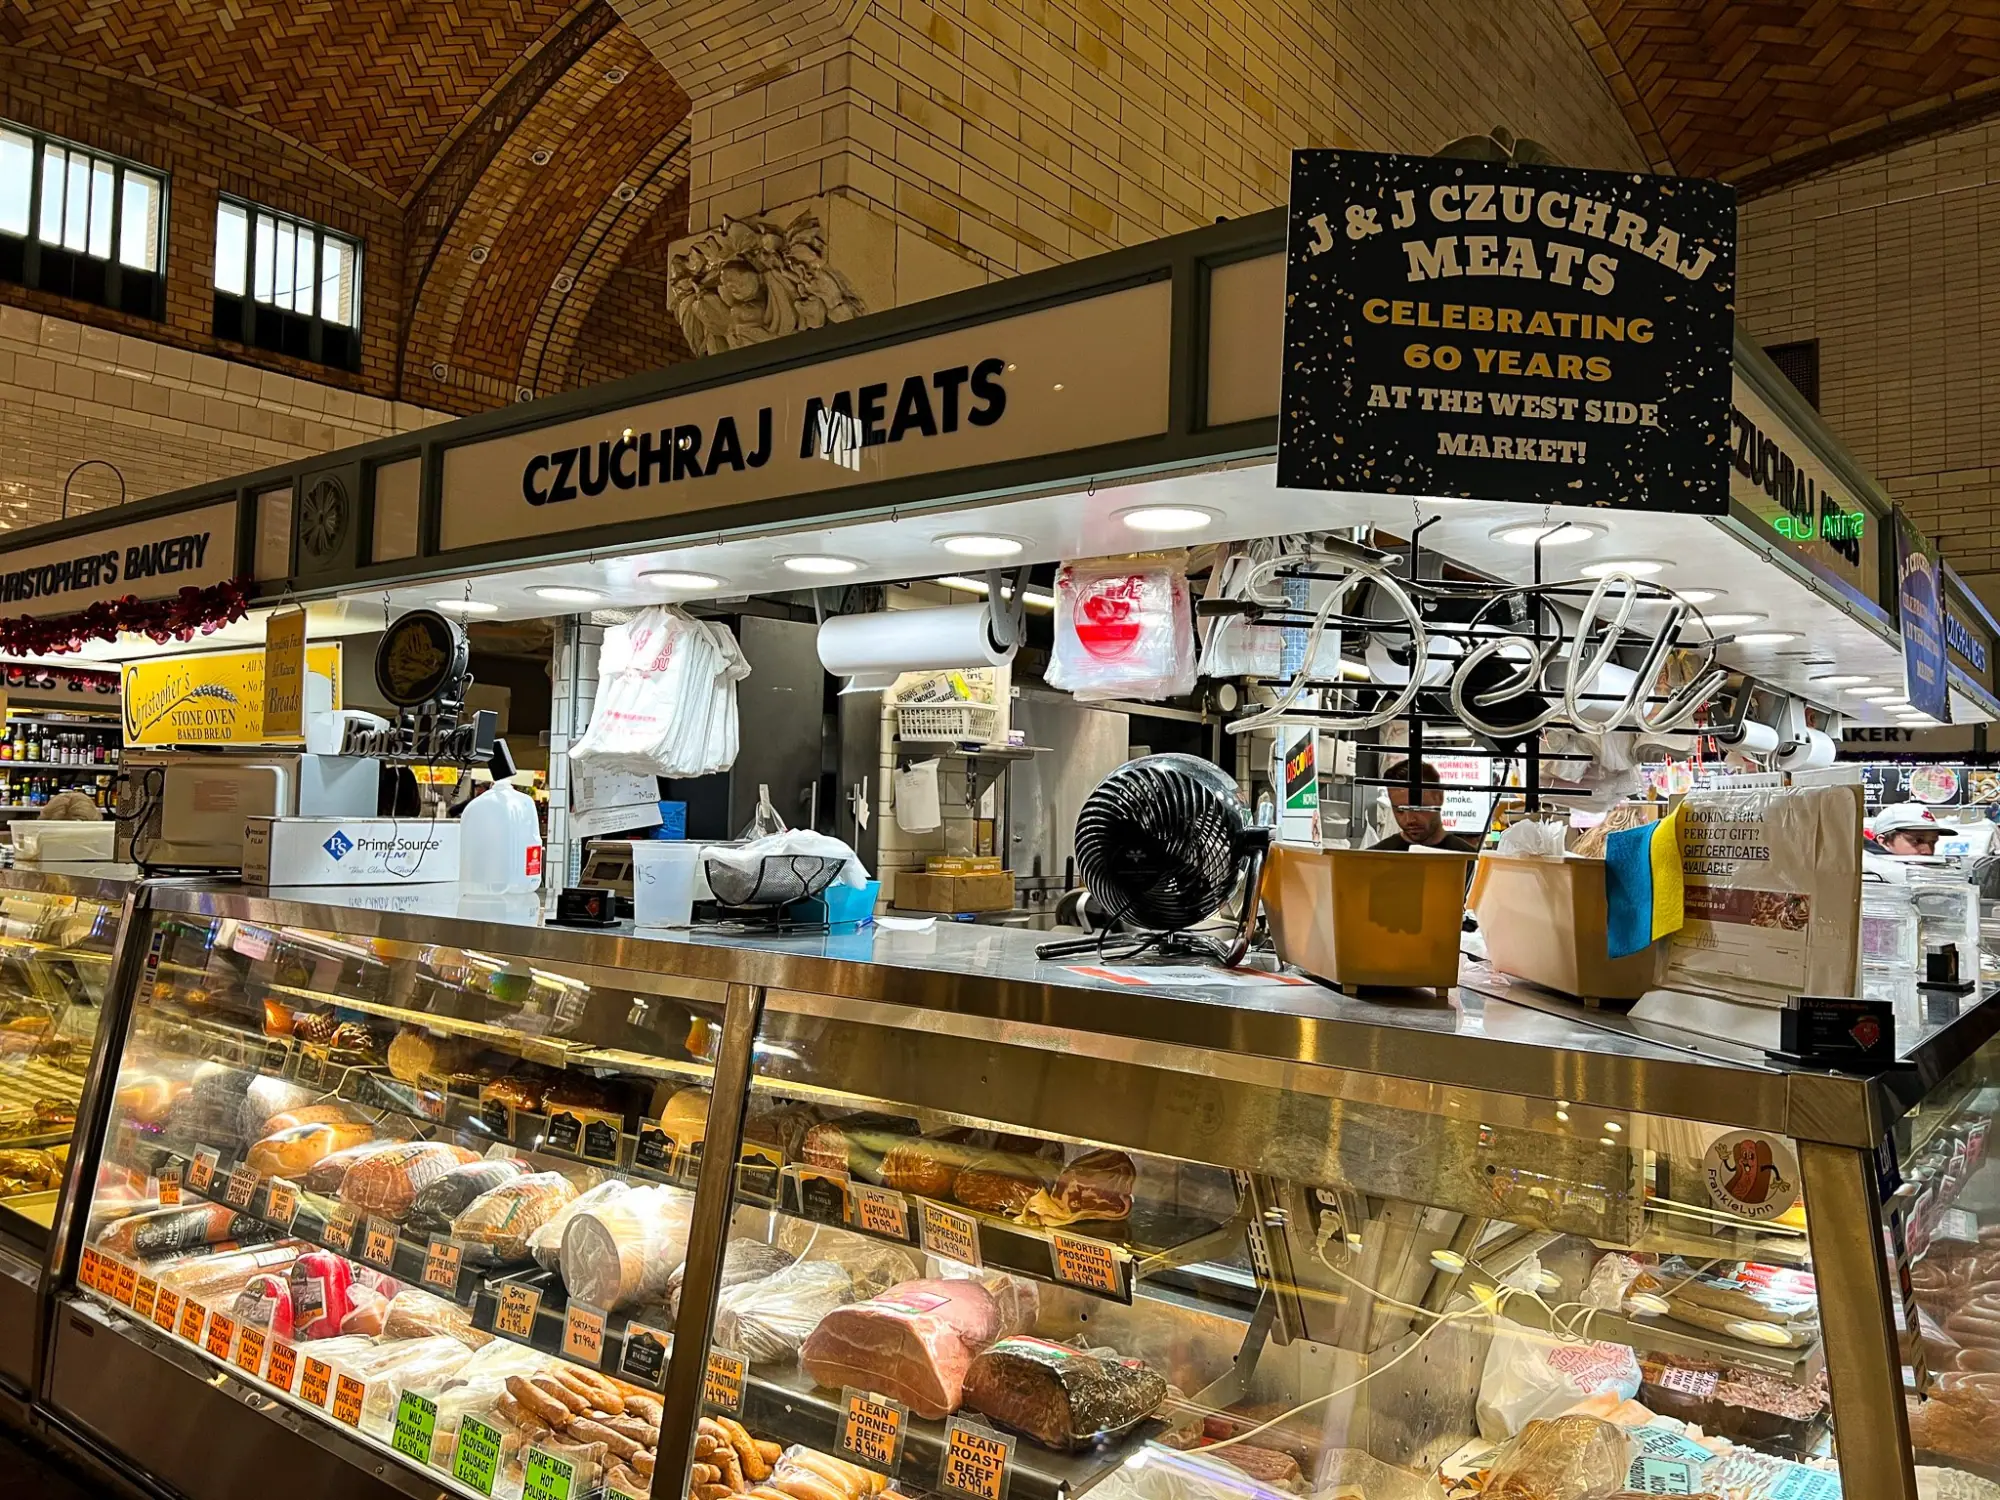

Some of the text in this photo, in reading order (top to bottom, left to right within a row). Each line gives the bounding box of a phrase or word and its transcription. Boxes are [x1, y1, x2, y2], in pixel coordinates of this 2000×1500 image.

[1307, 184, 1717, 282] J & J CZUCHRAJ
[1402, 235, 1620, 296] MEATS
[1362, 297, 1656, 344] CELEBRATING
[1403, 343, 1613, 382] 60 YEARS
[1367, 384, 1660, 427] AT THE WEST SIDE
[522, 357, 1008, 507] CZUCHRAJ MEATS
[1436, 432, 1588, 466] MARKET!
[123, 531, 211, 581] BAKERY
[246, 680, 259, 693] No
[124, 665, 192, 742] Christopher's
[248, 700, 259, 713] No
[268, 685, 299, 714] Breads
[171, 707, 236, 727] STONE OVEN
[249, 720, 260, 733] No
[177, 727, 232, 741] BAKED BREAD
[339, 714, 405, 757] Boar's
[1446, 796, 1472, 804] smoke.
[1684, 810, 1730, 824] LOOKING
[1758, 812, 1764, 823] A
[1684, 827, 1760, 841] PERFECT GIFT?
[329, 836, 439, 857] PS Prime Source
[1683, 845, 1770, 859] GIFT CERTICATES
[1683, 862, 1733, 875] AVAILABLE
[1695, 931, 1719, 948] VOID
[866, 1191, 885, 1204] HOT
[1708, 1168, 1774, 1217] FrankieLynn
[863, 1202, 896, 1221] CAPICOLA
[929, 1209, 968, 1233] HOT MILD
[927, 1220, 972, 1248] SOPRESSATA
[1060, 1237, 1105, 1257] IMPORTED
[1057, 1248, 1113, 1269] PROSCIUTTO
[1066, 1260, 1107, 1279] DI PARMA
[501, 1296, 532, 1315] PINEAPPLE
[408, 1410, 423, 1426] MILD
[858, 1401, 890, 1420] LEAN
[396, 1419, 432, 1447] POLISH BOYS
[849, 1411, 897, 1436] CORNED
[461, 1432, 496, 1459] SLOVENIAN
[856, 1428, 886, 1445] BEEF
[957, 1432, 1000, 1456] LEAN
[461, 1451, 490, 1475] SAUSAGE
[950, 1444, 1003, 1471] ROAST
[539, 1472, 555, 1489] HOT
[954, 1459, 994, 1482] BEEF
